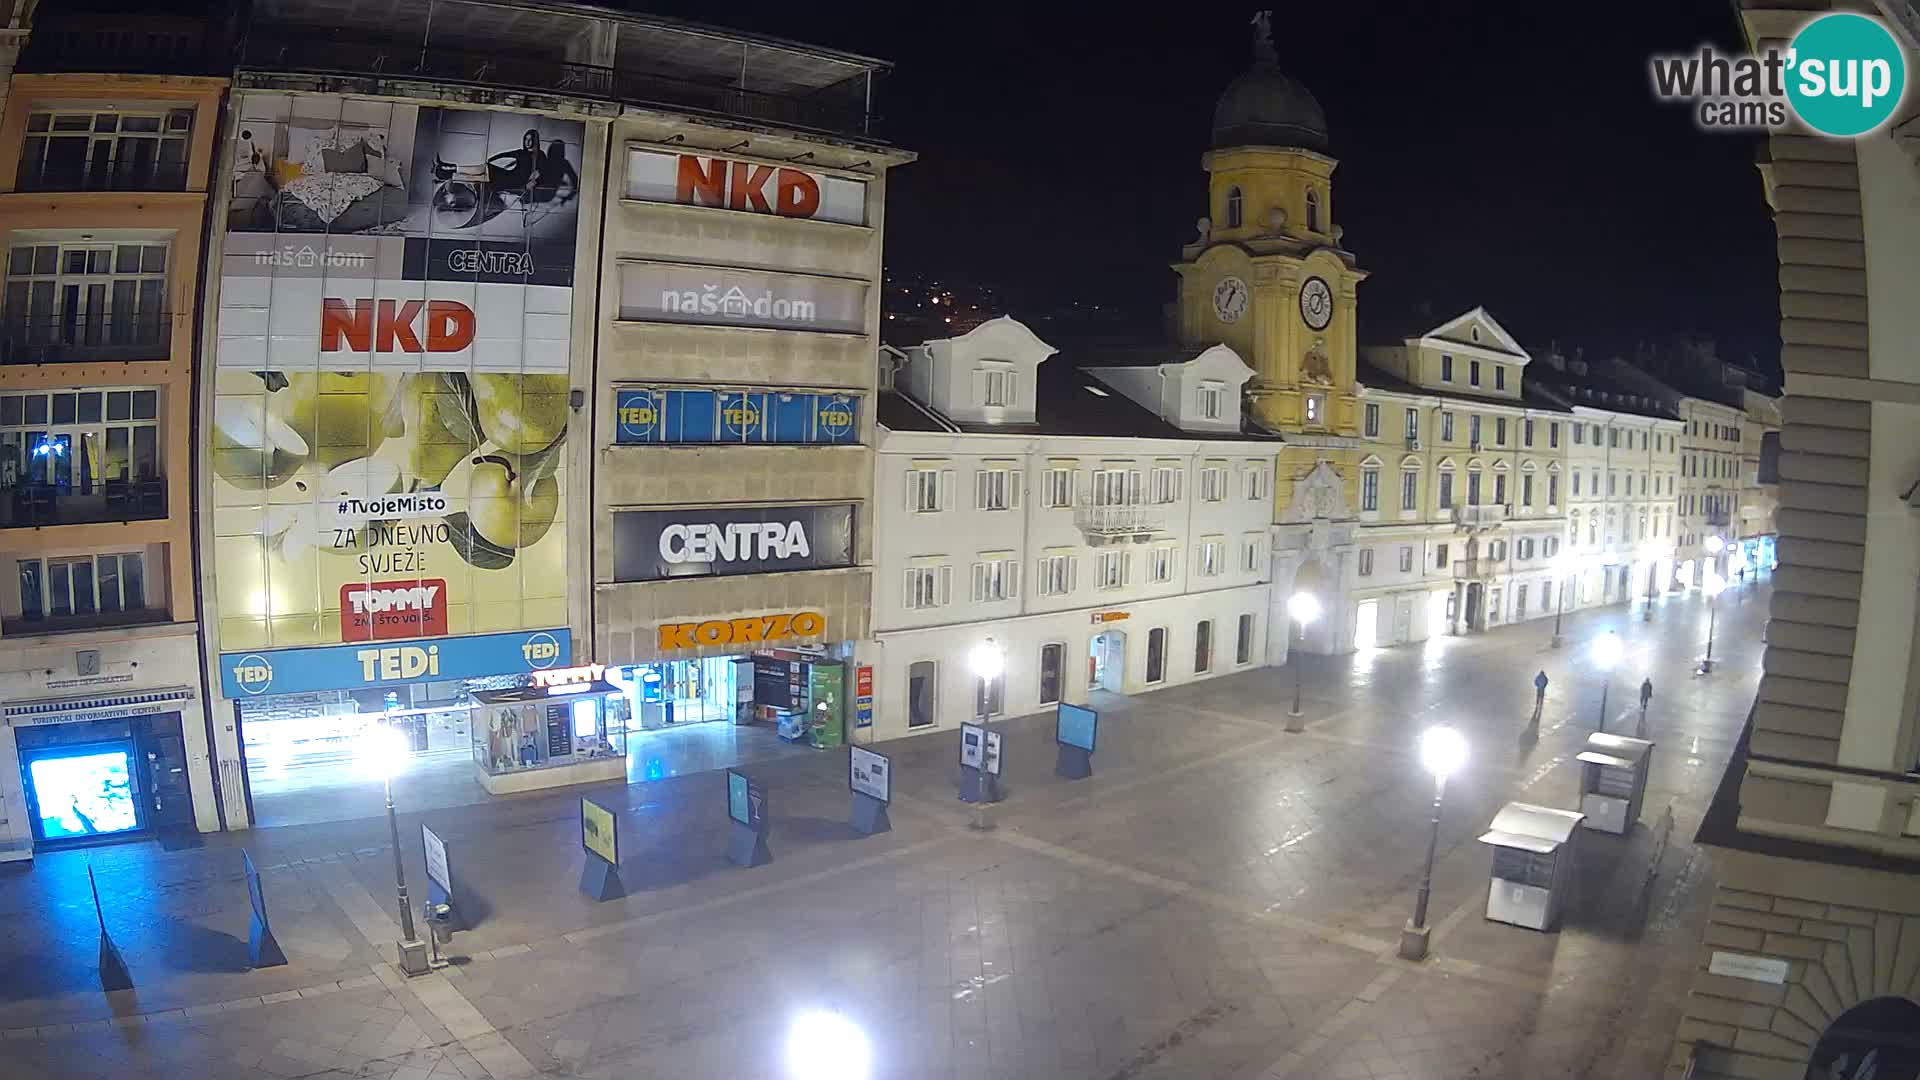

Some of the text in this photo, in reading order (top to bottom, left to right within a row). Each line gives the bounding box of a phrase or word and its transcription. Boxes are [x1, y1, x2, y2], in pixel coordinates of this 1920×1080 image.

[676, 153, 820, 218] NKD
[255, 244, 365, 268] naš dom
[448, 249, 534, 274] CENTRA
[661, 284, 816, 322] naš dom
[320, 297, 476, 353] NKD
[619, 408, 657, 425] TEDi
[723, 409, 759, 425] TEDi
[819, 411, 852, 426] TEDi
[338, 497, 446, 515] #TvojeMisto
[333, 523, 450, 548] ZA DNEVNO
[659, 521, 810, 564] CENTRA
[360, 547, 425, 574] SVJEŽE
[348, 586, 439, 614] TOMMY
[658, 612, 826, 650] KORZO
[357, 645, 439, 682] TEDi
[522, 643, 560, 661] TEDi
[233, 664, 273, 685] TEDi
